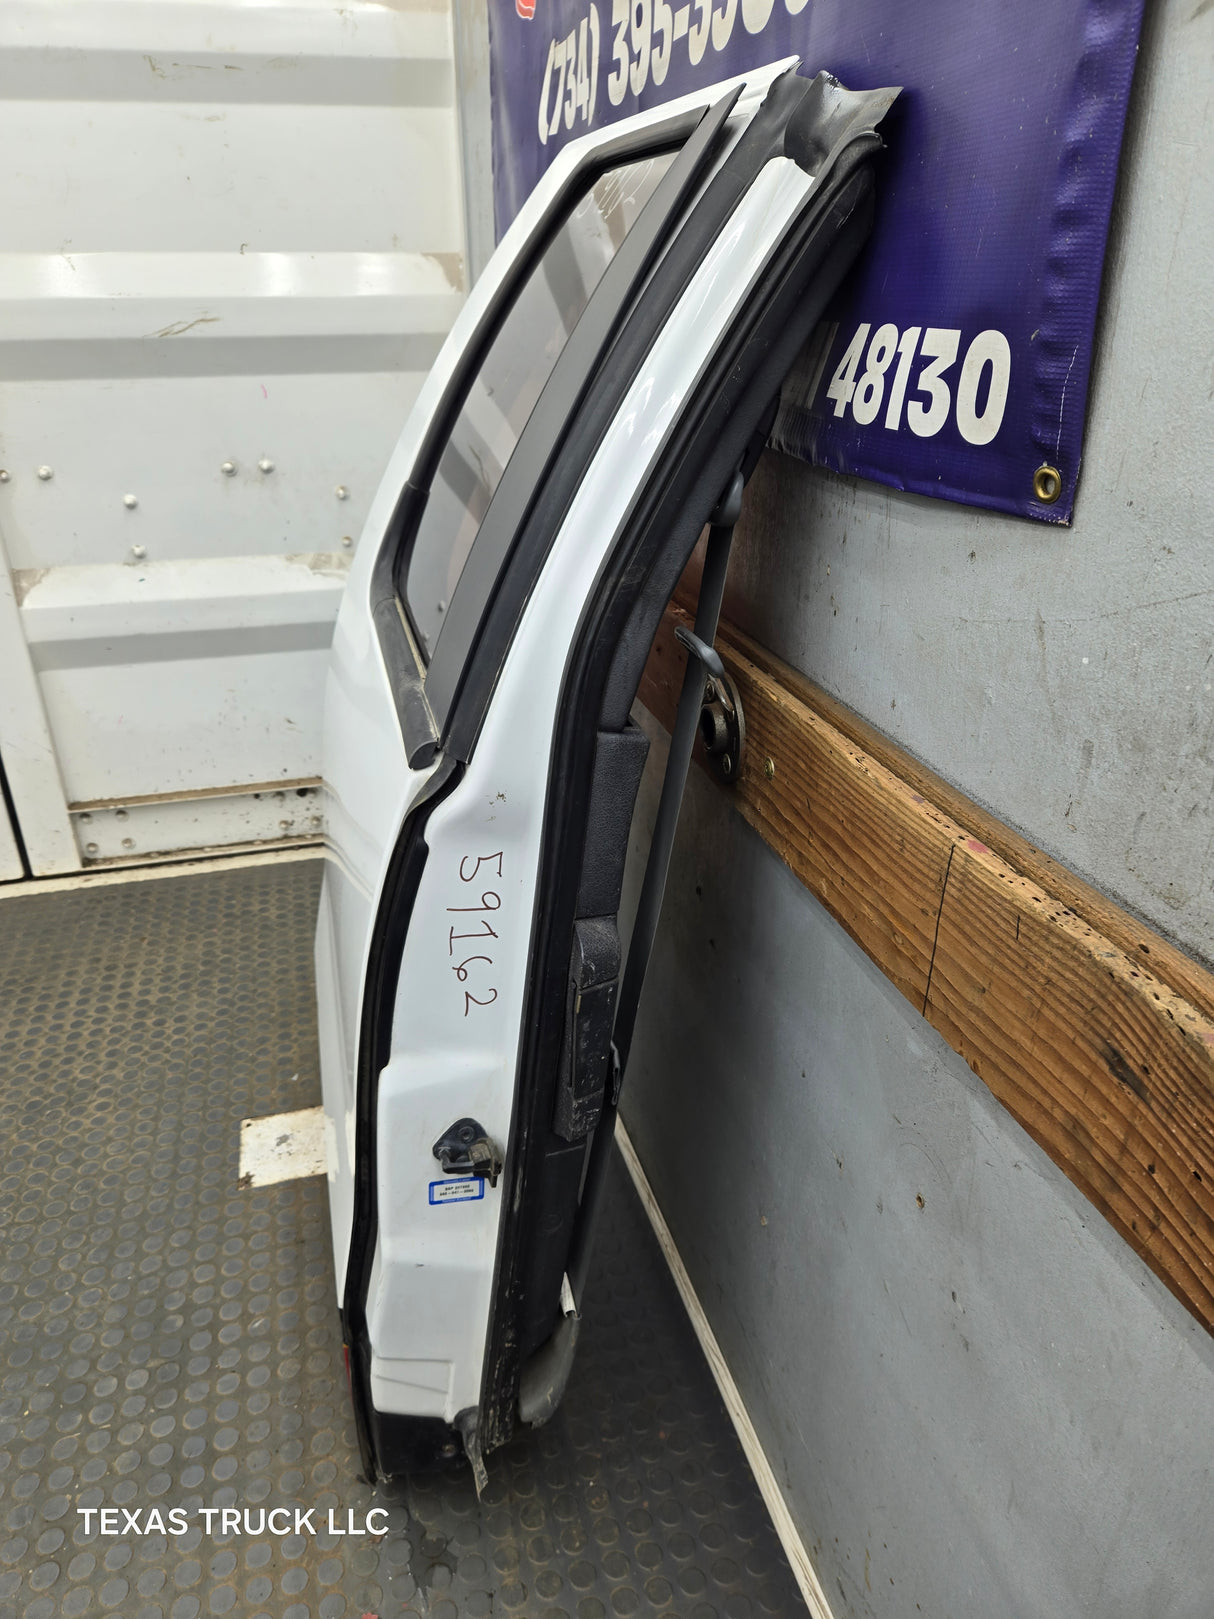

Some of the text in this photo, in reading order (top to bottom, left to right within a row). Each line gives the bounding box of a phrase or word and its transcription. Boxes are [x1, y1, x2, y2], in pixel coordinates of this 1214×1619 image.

[538, 2, 600, 145] (734)
[826, 322, 1012, 446] 48130
[446, 851, 504, 1017] 59162
